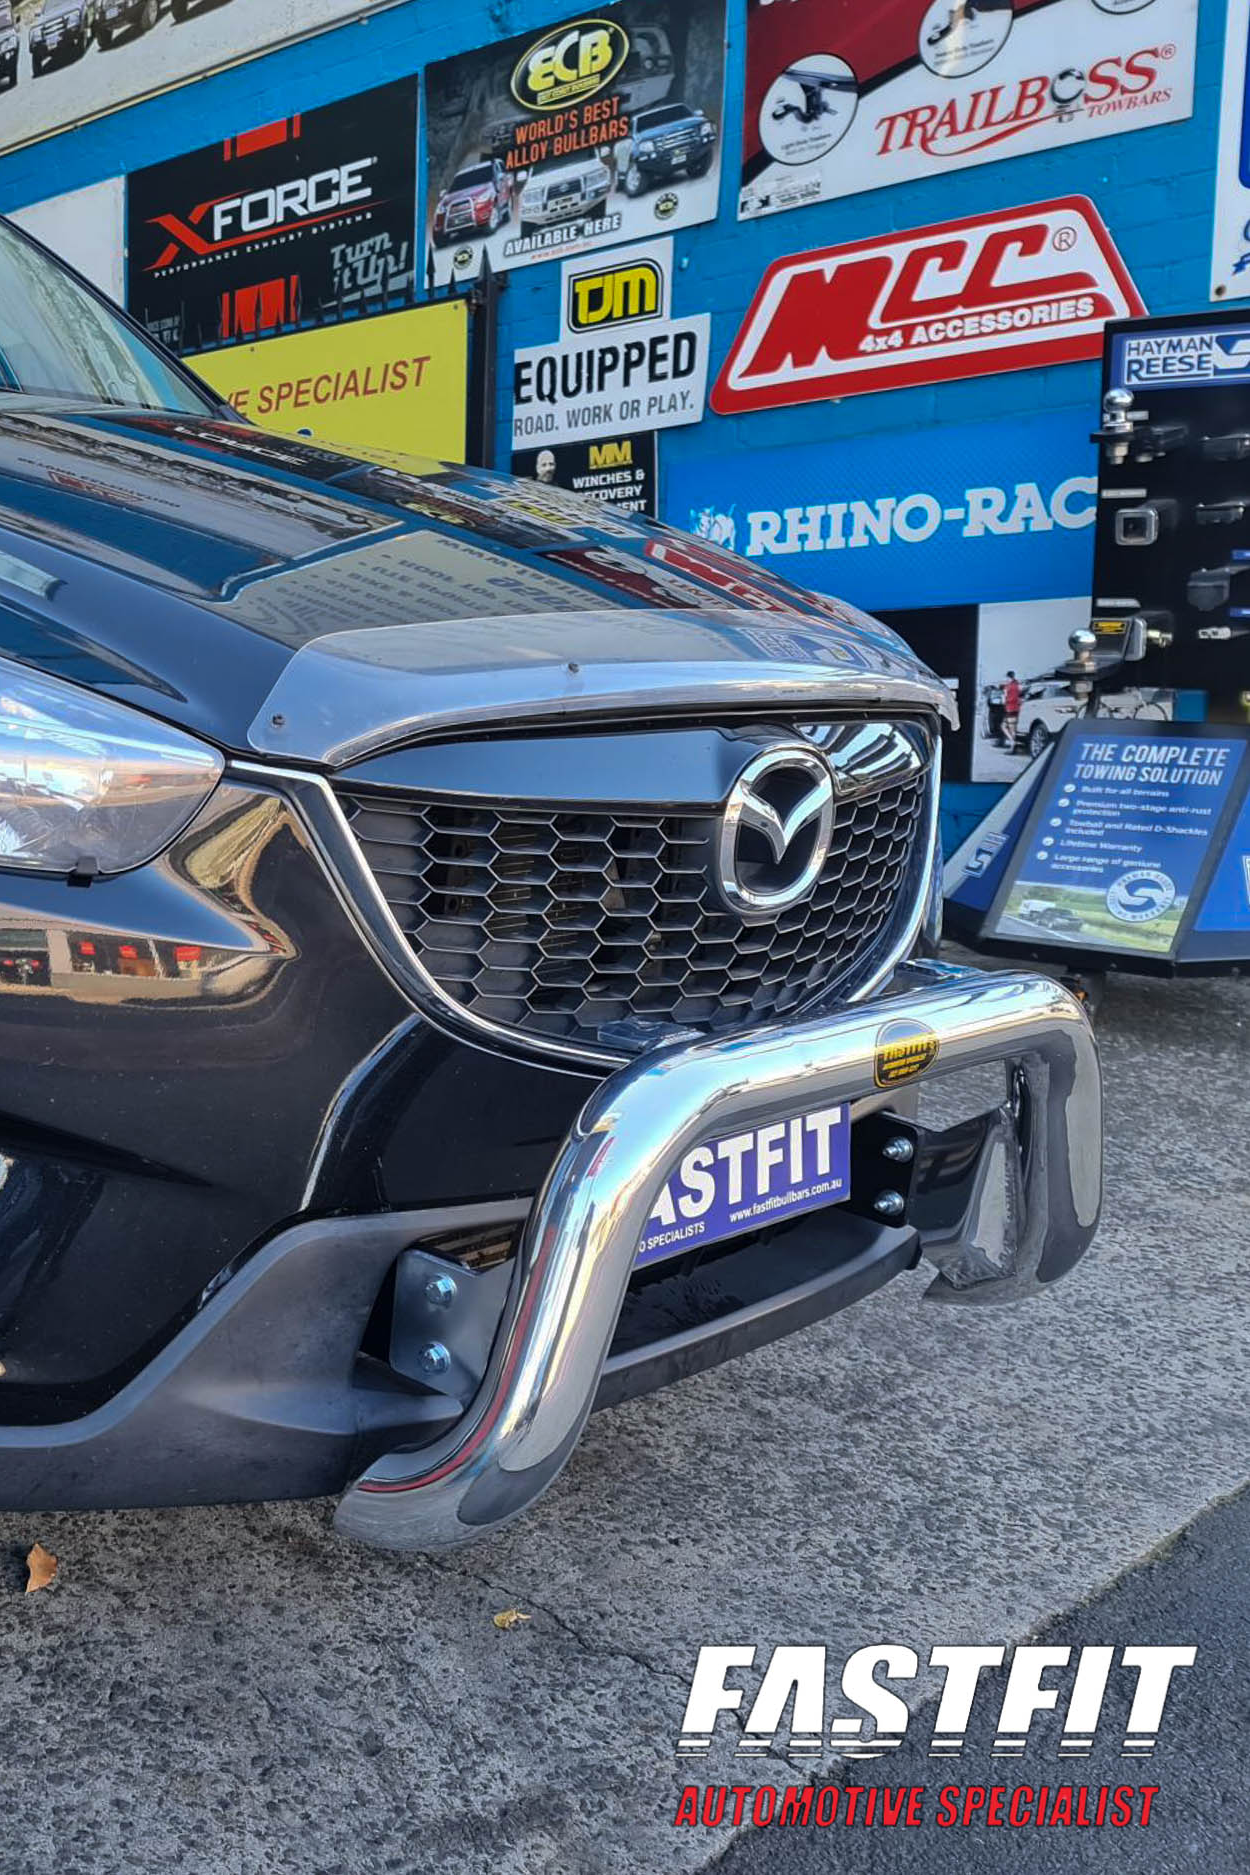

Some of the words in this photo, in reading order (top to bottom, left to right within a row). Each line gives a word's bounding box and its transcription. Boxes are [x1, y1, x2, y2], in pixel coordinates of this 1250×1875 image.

[527, 29, 613, 91] ECB
[515, 109, 579, 145] WORLD'S
[584, 96, 620, 125] BEST
[1088, 88, 1171, 119] TOWBARS
[506, 140, 548, 170] ALLOY
[554, 116, 629, 156] BULLBARS
[154, 249, 238, 278] PERFORMANCE
[246, 231, 303, 253] EXHAUST
[311, 212, 372, 234] SYSTEMS
[330, 232, 392, 269] Turn
[504, 225, 578, 257] AVAILABLE
[584, 213, 622, 237] HERE
[858, 329, 904, 354] 4x4
[910, 296, 1095, 346] ACCESSORIES
[1127, 336, 1213, 357] HAYMAN
[257, 355, 431, 415] SPECIALIST
[514, 331, 698, 406] EQUIPPED
[1126, 353, 1212, 383] REESE
[514, 413, 559, 437] ROAD.
[566, 402, 613, 429] WORK
[619, 400, 641, 421] OR
[646, 390, 694, 416] PLAY.
[572, 472, 632, 489] WINCHES
[635, 469, 645, 481] &
[583, 485, 642, 501] ECOVERY
[746, 476, 1098, 557] RHINO-RAC
[1074, 763, 1136, 781] TOWING
[1140, 767, 1223, 786] SOLUTION
[1080, 743, 1117, 762] THE
[1121, 745, 1230, 767] COMPLETE
[647, 1105, 842, 1226] ASTFIT
[729, 1178, 842, 1222] www.fastfitbullbars.com.au
[647, 1221, 705, 1250] SPECIALISTS
